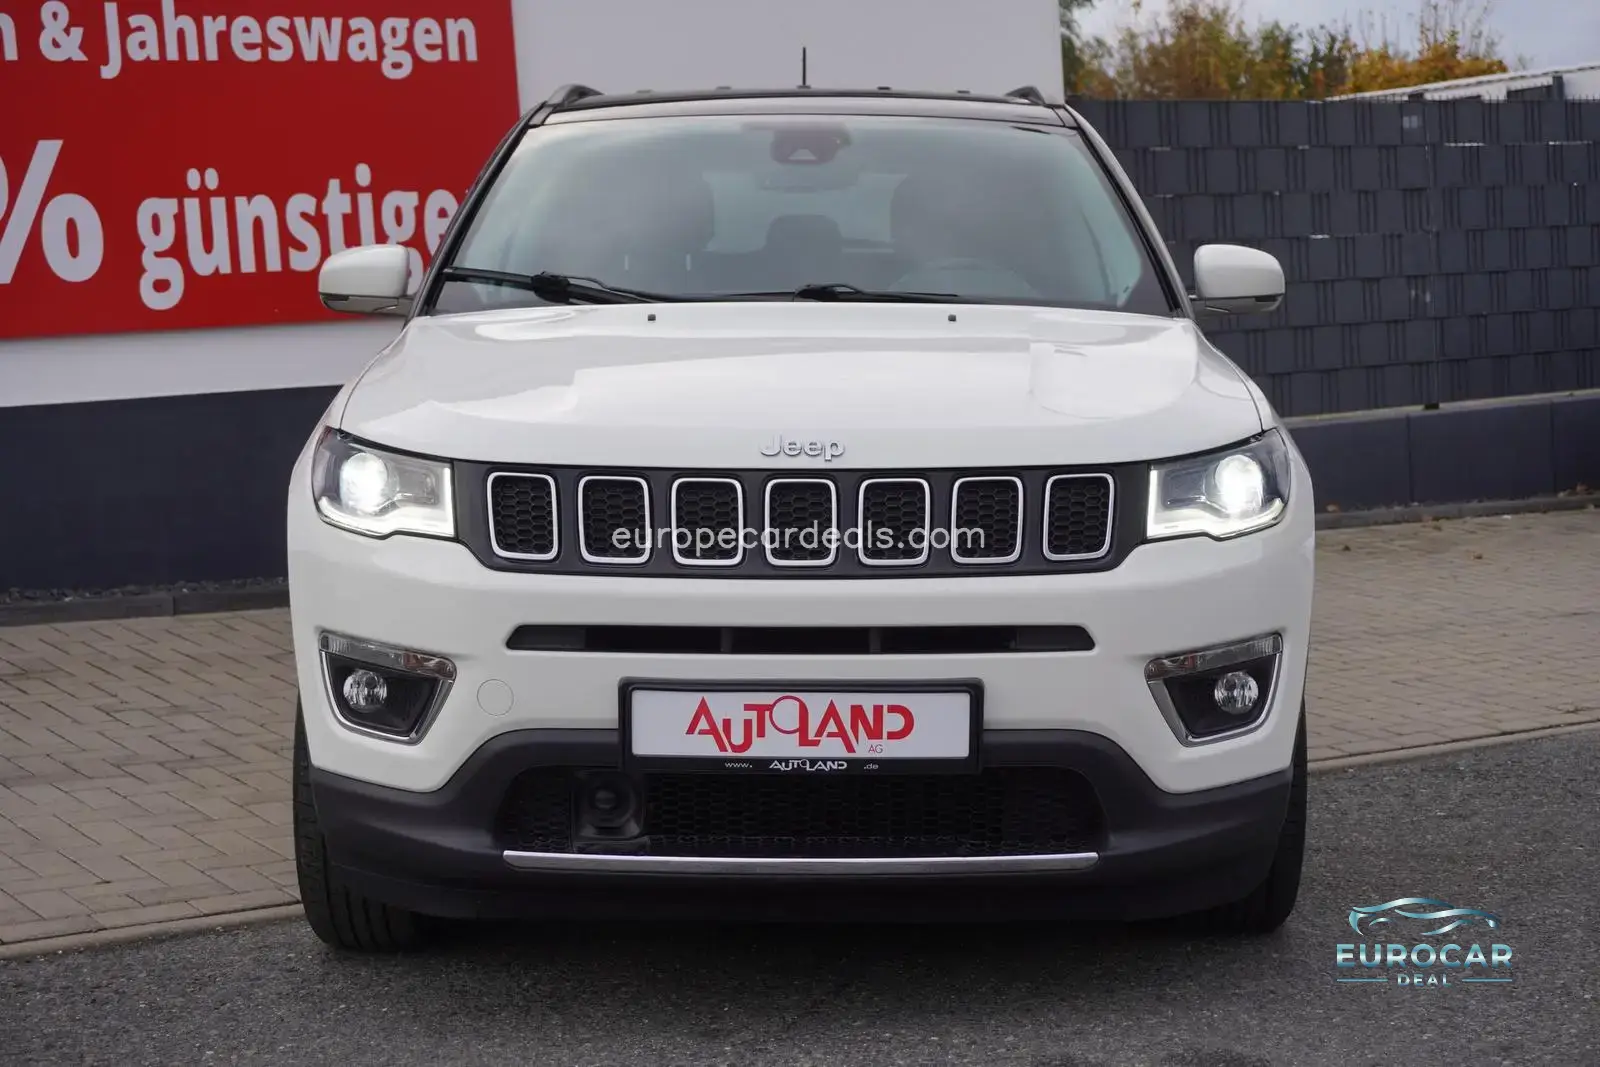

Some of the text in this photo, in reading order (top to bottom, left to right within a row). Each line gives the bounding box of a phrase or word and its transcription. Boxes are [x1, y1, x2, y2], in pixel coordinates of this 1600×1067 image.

[39, 0, 89, 62] &
[100, 0, 478, 80] Jahreswagen
[136, 162, 467, 311] günstige
[760, 436, 846, 461] Jeep
[685, 695, 914, 753] AUTOLAND
[769, 759, 847, 771] AUTOLAND
[863, 762, 879, 770] .de
[868, 744, 884, 754] AG
